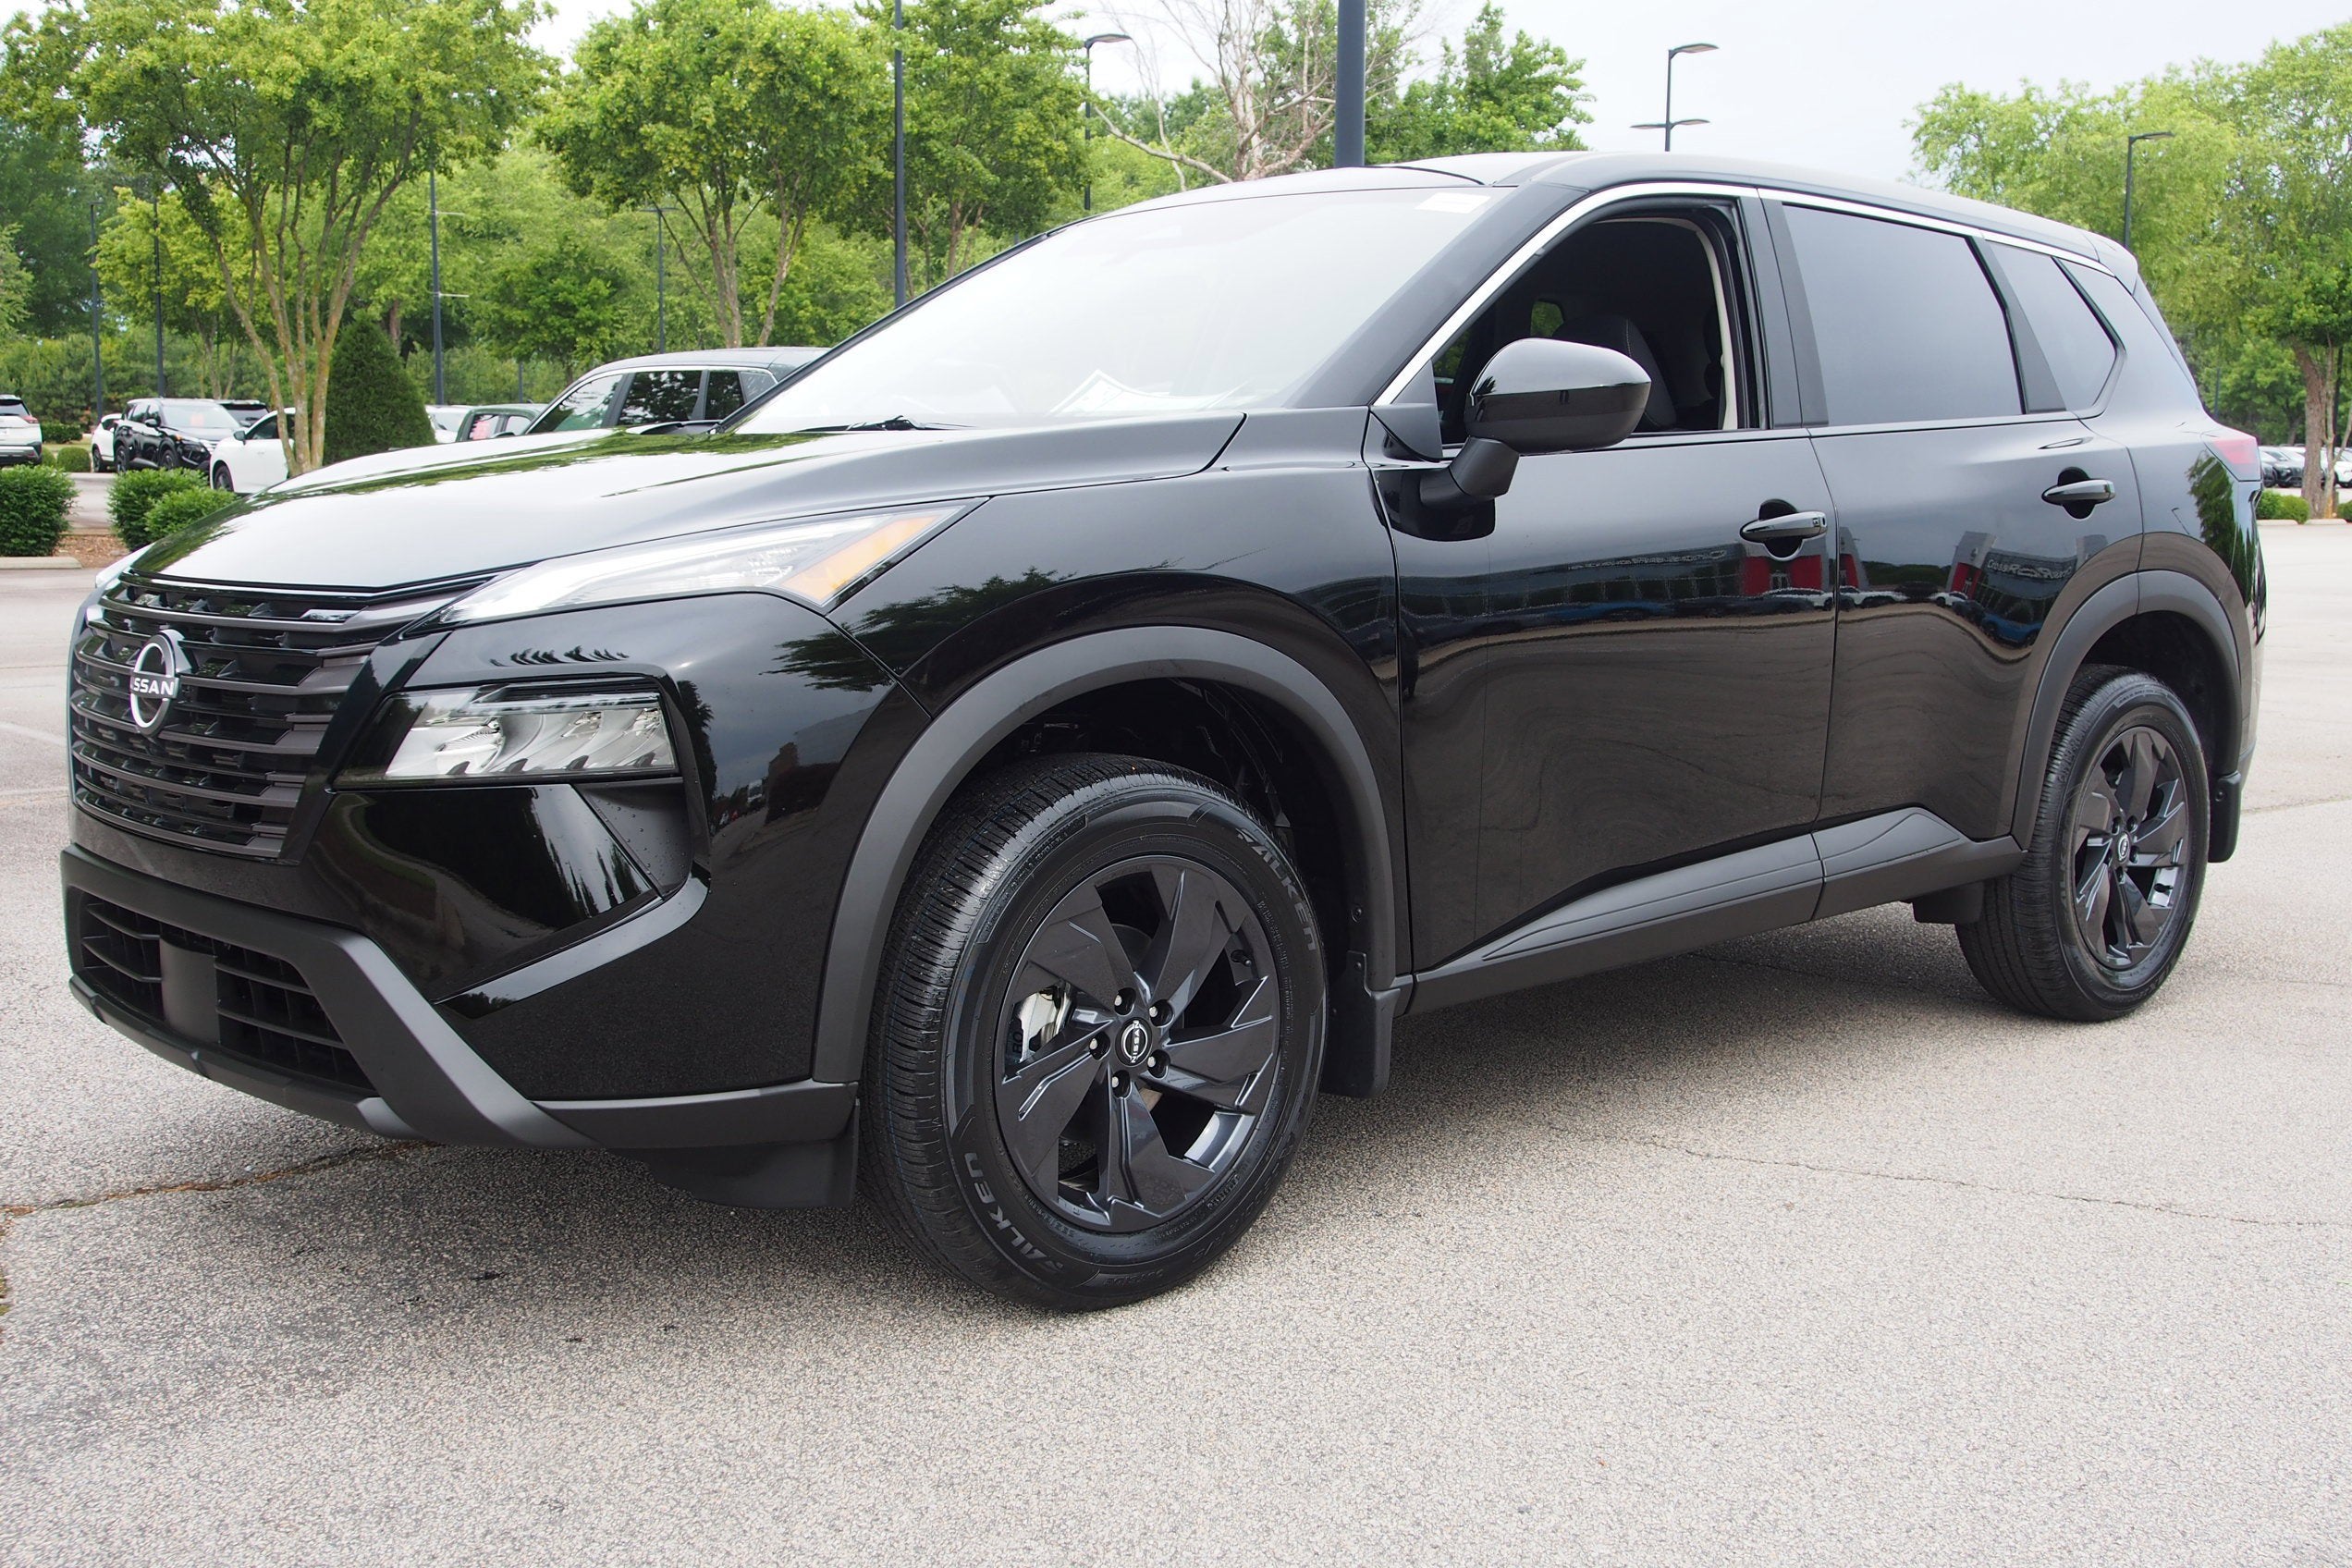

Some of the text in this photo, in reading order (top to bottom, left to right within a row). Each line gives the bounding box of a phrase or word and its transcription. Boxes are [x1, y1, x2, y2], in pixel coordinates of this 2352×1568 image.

[133, 677, 175, 696] SSAN
[1236, 827, 1317, 950] FALKEN
[1131, 1020, 1140, 1063] NISSAN
[964, 1152, 1064, 1271] FALKEN
